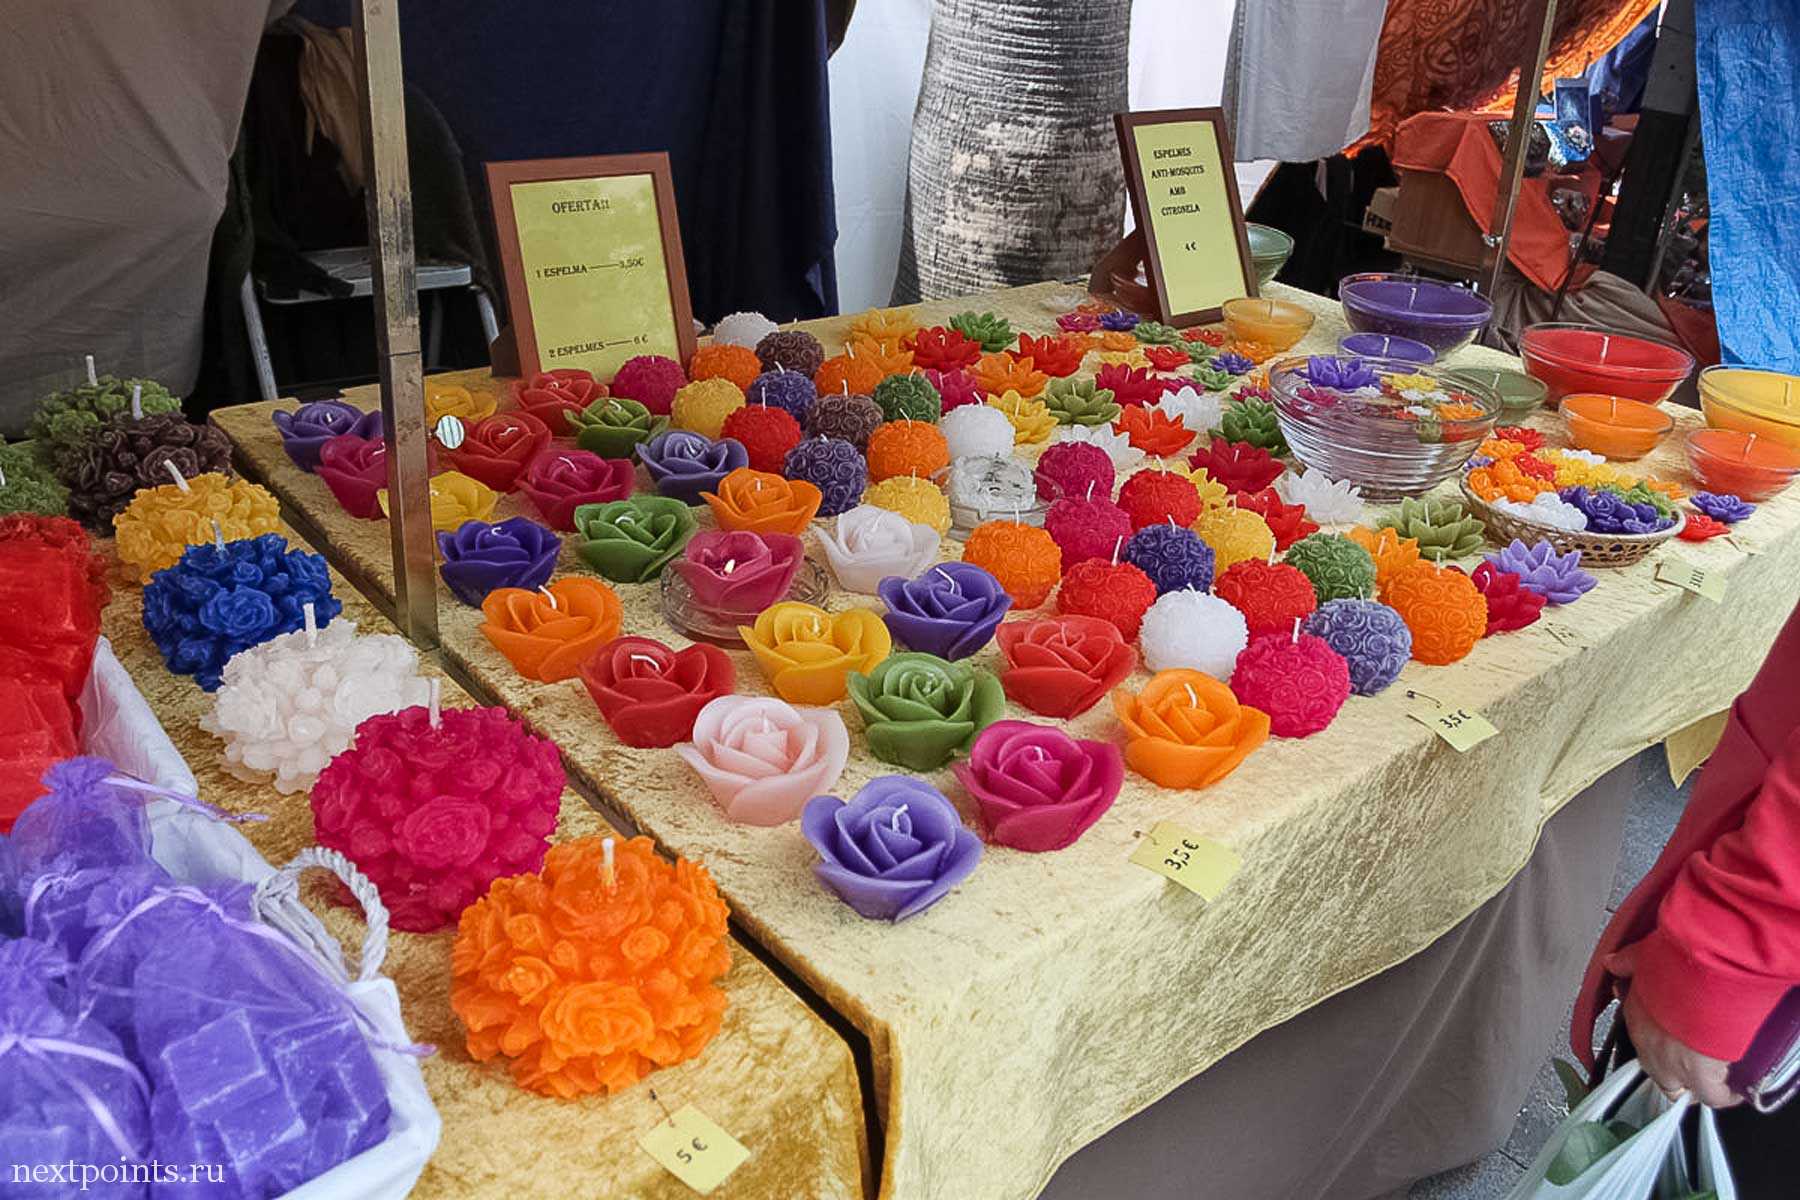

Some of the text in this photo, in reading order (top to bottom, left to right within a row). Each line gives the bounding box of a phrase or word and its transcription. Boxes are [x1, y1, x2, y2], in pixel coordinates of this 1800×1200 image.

[1151, 165, 1205, 179] ANTI-MOSQUITS
[1169, 186, 1187, 197] AMB
[1160, 203, 1201, 217] CITRONELA
[543, 265, 588, 278] ESPELMA
[548, 349, 556, 358] 2
[557, 341, 606, 357] ESPELMES
[676, 1148, 692, 1165] 5
